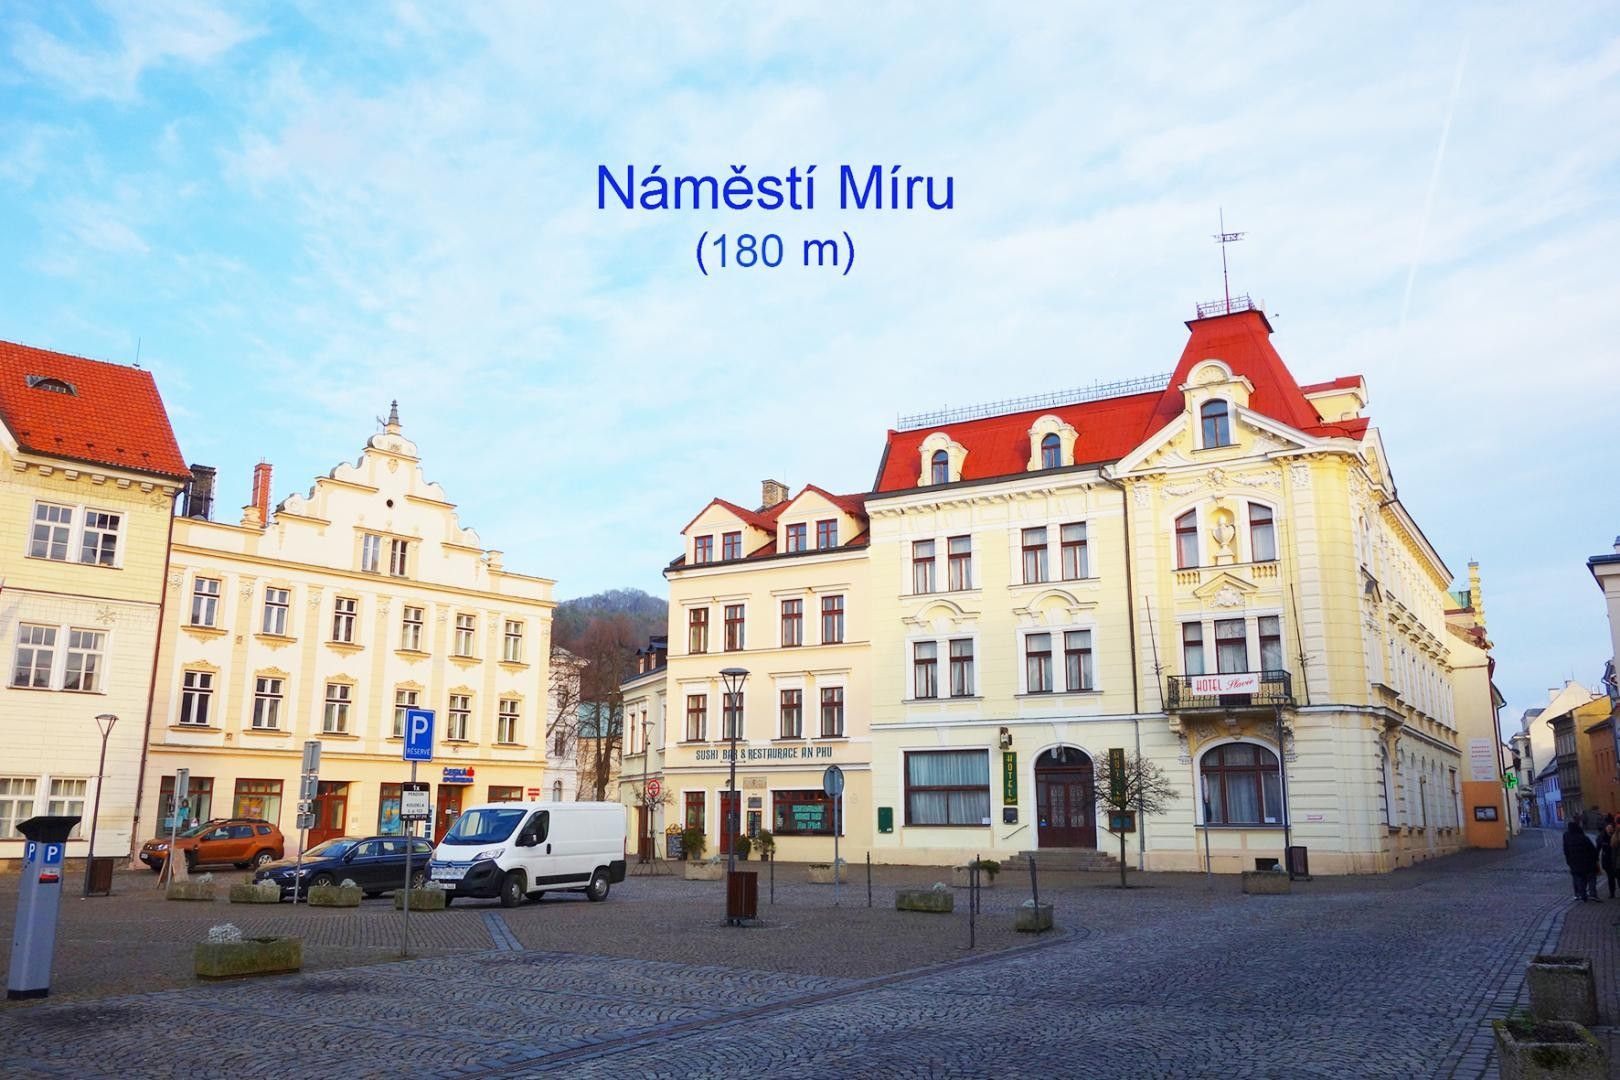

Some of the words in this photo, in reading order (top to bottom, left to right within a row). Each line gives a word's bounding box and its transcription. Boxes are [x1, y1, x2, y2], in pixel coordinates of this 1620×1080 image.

[1196, 678, 1222, 692] HOTEL
[411, 716, 429, 745] P
[695, 749, 719, 760] SUSHI
[740, 748, 746, 759] &
[748, 746, 798, 760] RESTAURACE
[801, 746, 812, 758] AN
[28, 843, 36, 859] P
[47, 846, 58, 862] P
